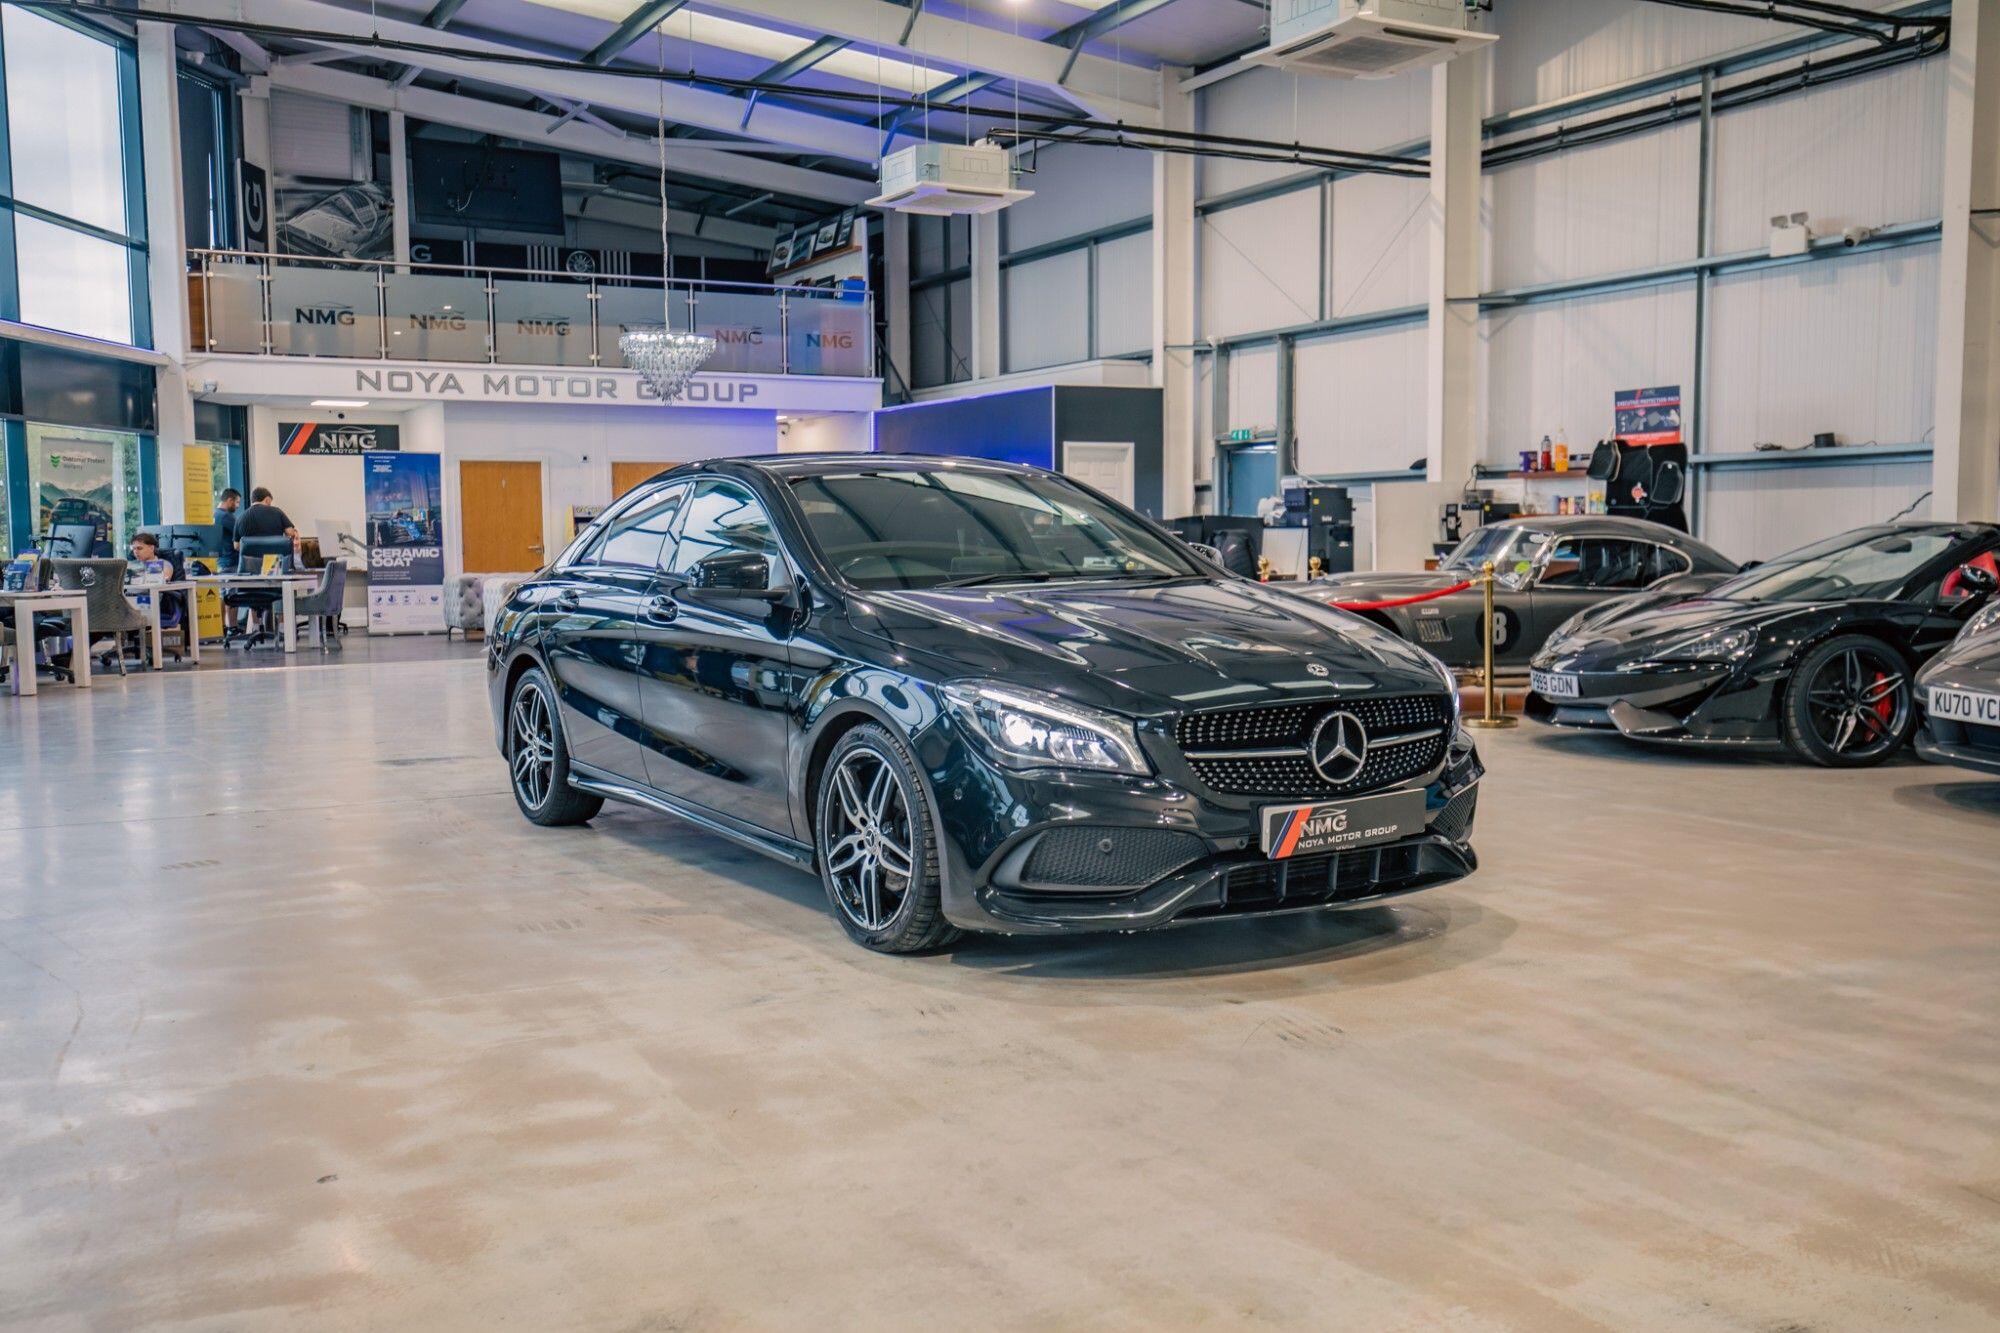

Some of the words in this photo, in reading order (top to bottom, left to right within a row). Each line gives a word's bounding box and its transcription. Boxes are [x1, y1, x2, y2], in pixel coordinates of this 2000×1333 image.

[295, 308, 355, 326] NMG
[409, 313, 467, 331] NMG
[517, 319, 571, 336] NMG
[806, 332, 852, 349] NMG
[356, 369, 464, 395] NOYA
[482, 373, 618, 400] MOTOR
[636, 380, 759, 403] GOUP
[319, 432, 377, 449] NMG
[371, 547, 440, 559] CERAMIC
[371, 557, 414, 567] COAT
[1550, 676, 1574, 695] GDN
[1935, 690, 1971, 717] KU70
[1976, 696, 2000, 721] VC
[1300, 814, 1348, 838] NMG
[1298, 838, 1325, 849] NOYA
[1327, 831, 1362, 844] MOTOR
[1364, 824, 1398, 838] GROUP
